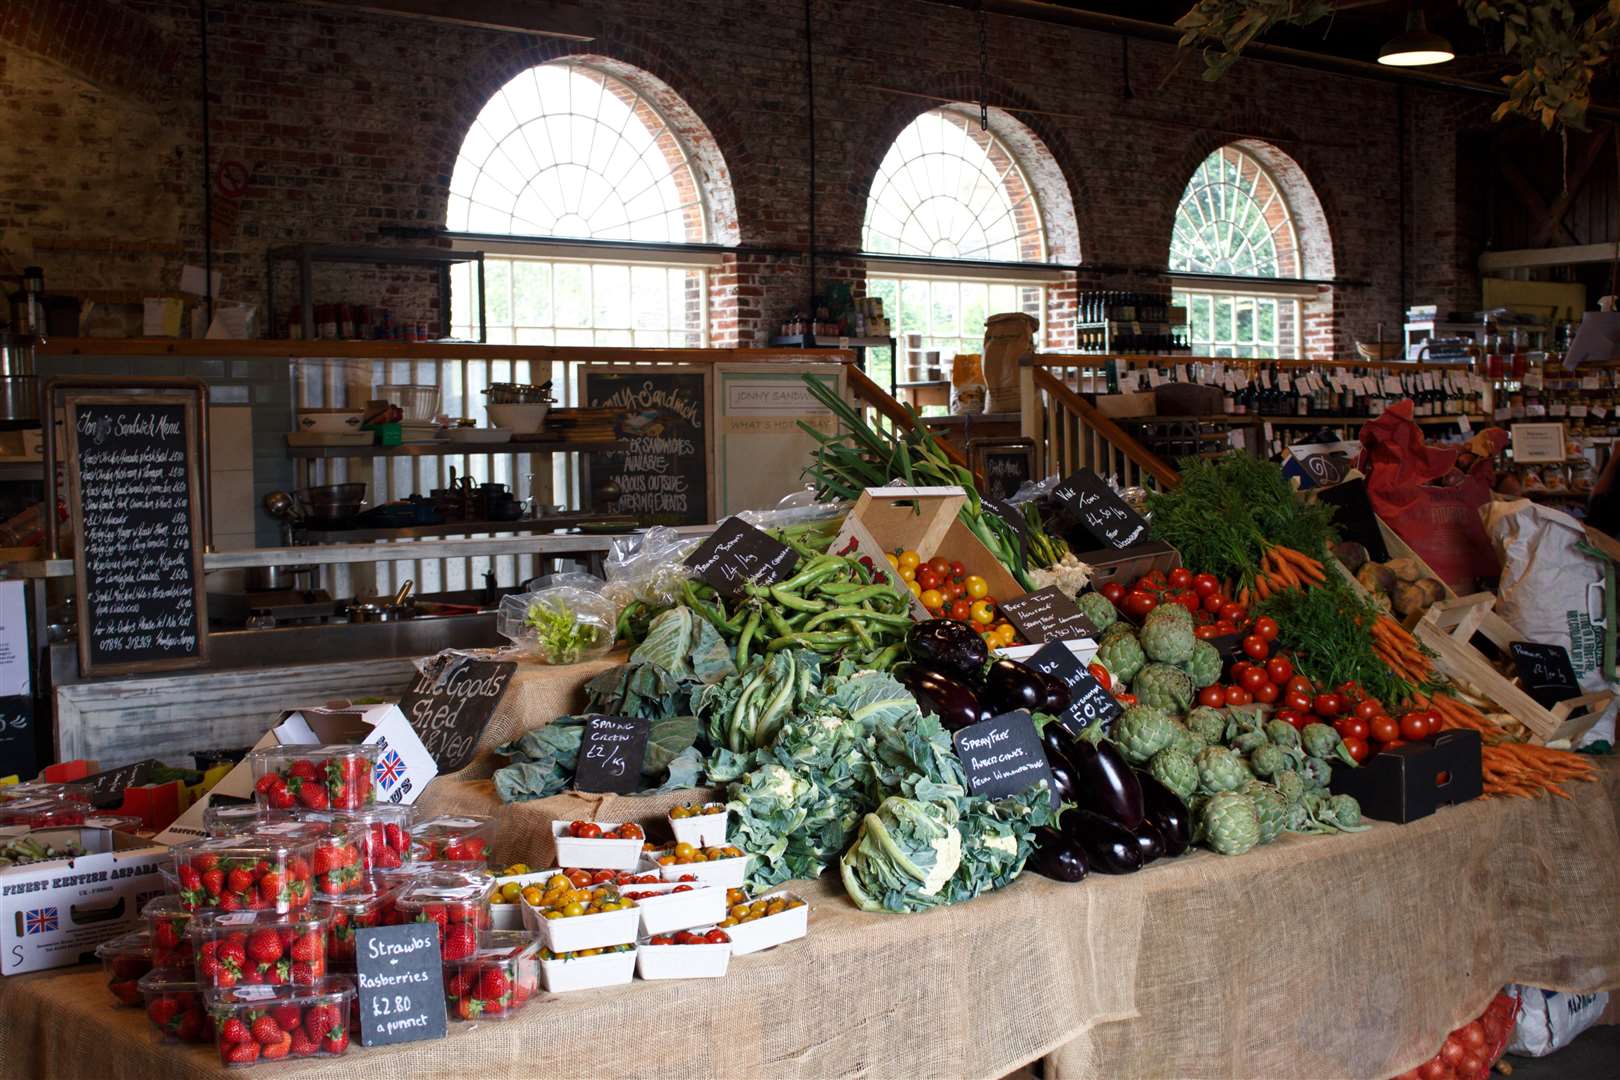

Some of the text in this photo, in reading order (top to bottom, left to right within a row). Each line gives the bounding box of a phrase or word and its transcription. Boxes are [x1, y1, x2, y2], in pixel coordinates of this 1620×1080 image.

[640, 380, 701, 429] Sandwich
[114, 413, 155, 437] Sandwich
[155, 414, 181, 440] Menu
[446, 664, 506, 703] Goods
[411, 697, 468, 730] Shed
[440, 731, 473, 768] Veg
[3, 880, 49, 896] FINEST
[52, 870, 108, 889] KENTISH
[368, 936, 432, 959] Strawbs
[359, 971, 430, 988] Rasberries
[372, 995, 411, 1017] £2.80
[376, 1014, 428, 1035] a punnet
